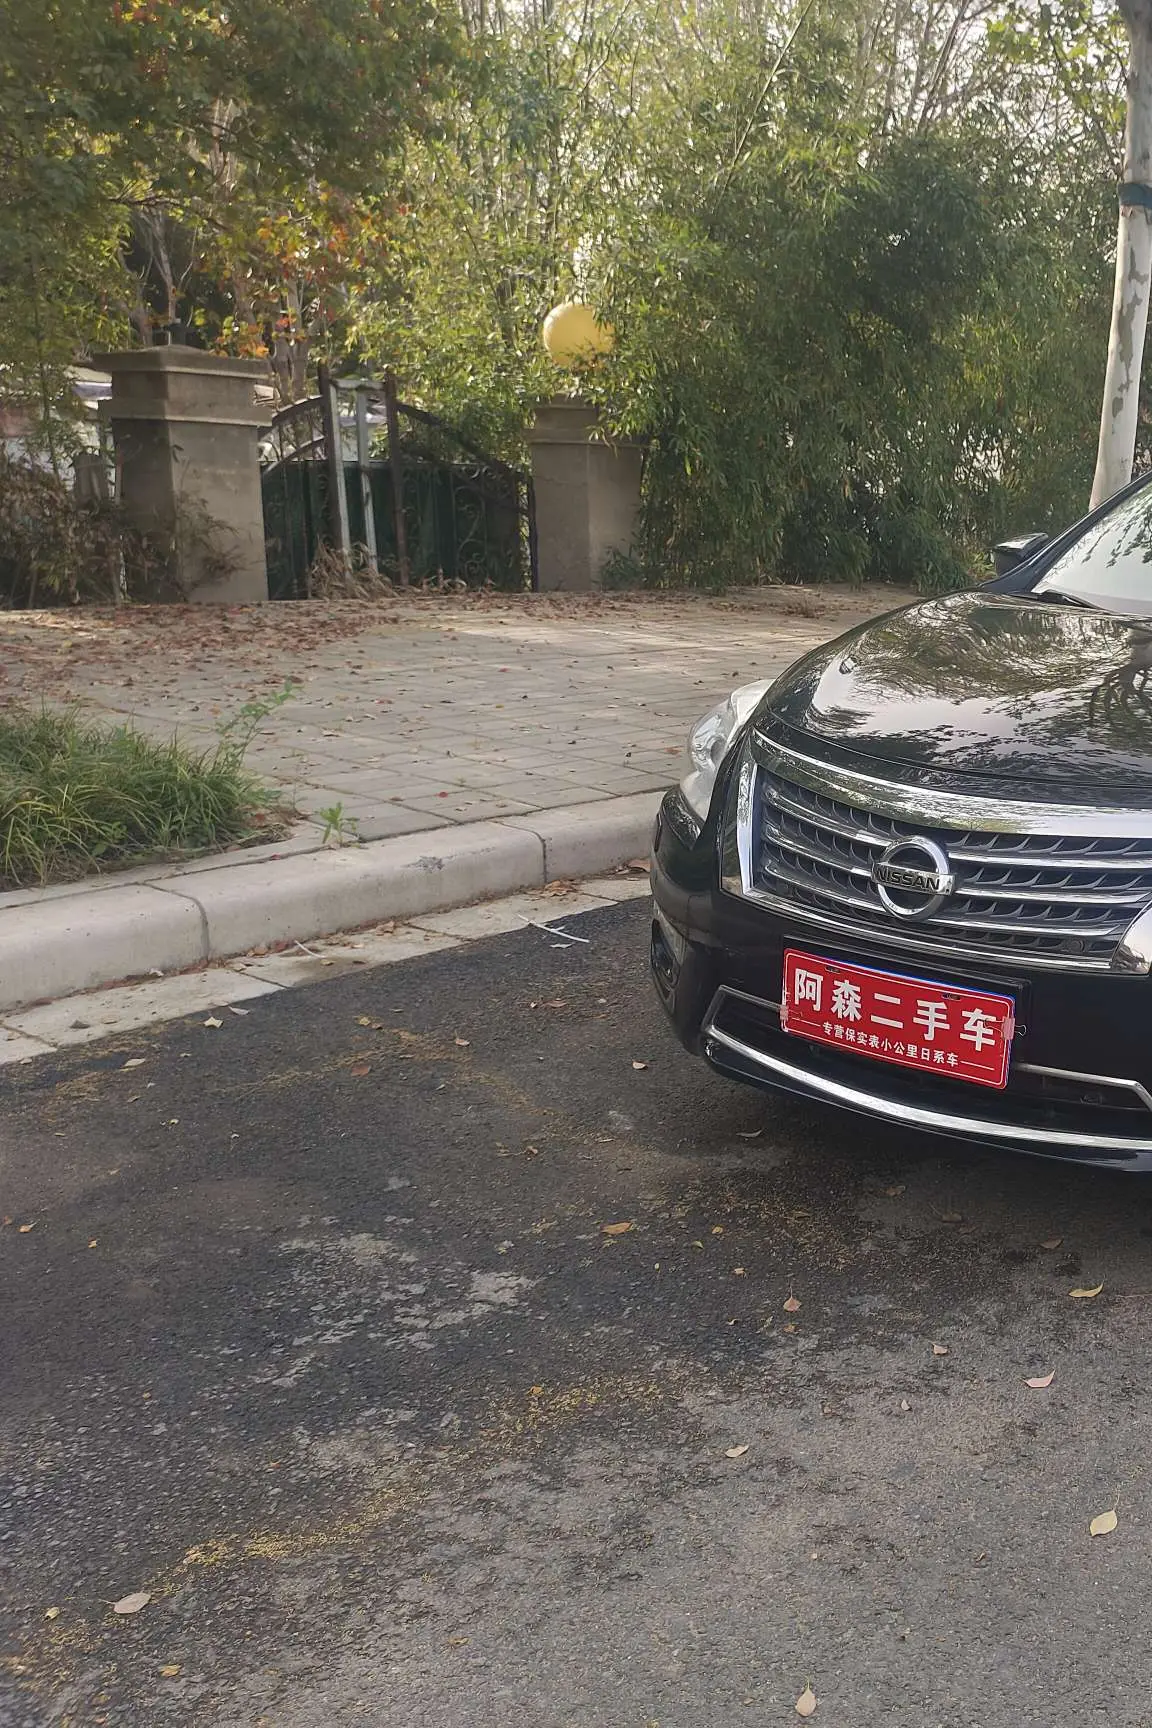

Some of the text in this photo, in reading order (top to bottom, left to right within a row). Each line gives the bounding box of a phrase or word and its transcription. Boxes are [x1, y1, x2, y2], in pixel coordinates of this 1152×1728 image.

[874, 865, 940, 891] NISSAN
[794, 967, 997, 1052] 阿森二手车
[822, 1021, 959, 1067] 专营保实表小公里日系车
